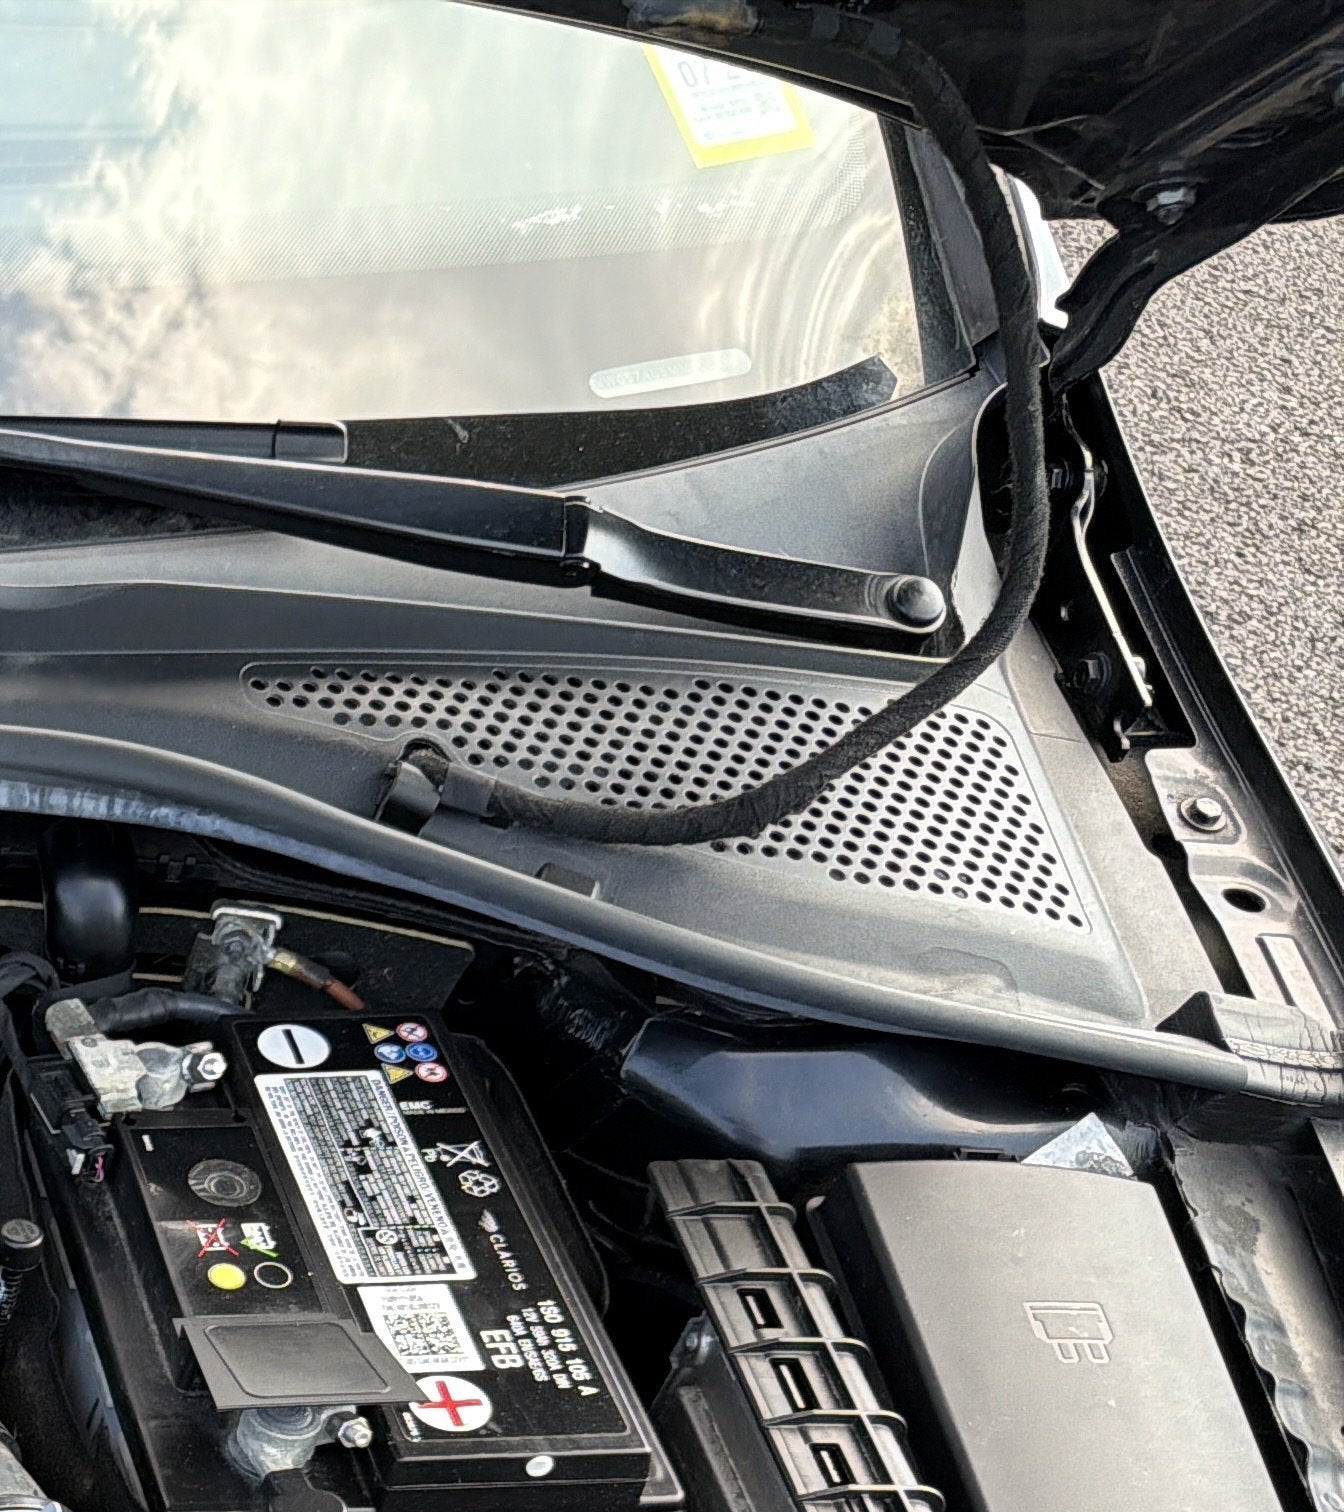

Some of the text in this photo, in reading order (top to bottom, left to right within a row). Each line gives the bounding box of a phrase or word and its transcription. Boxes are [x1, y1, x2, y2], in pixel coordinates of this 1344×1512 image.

[490, 1234, 528, 1291] CLARIOS
[480, 1329, 525, 1369] EFB
[521, 1308, 540, 1323] 12V
[552, 1373, 574, 1389] DIN
[551, 1328, 579, 1352] 915
[566, 1358, 593, 1381] 105
[578, 1385, 600, 1396] A
